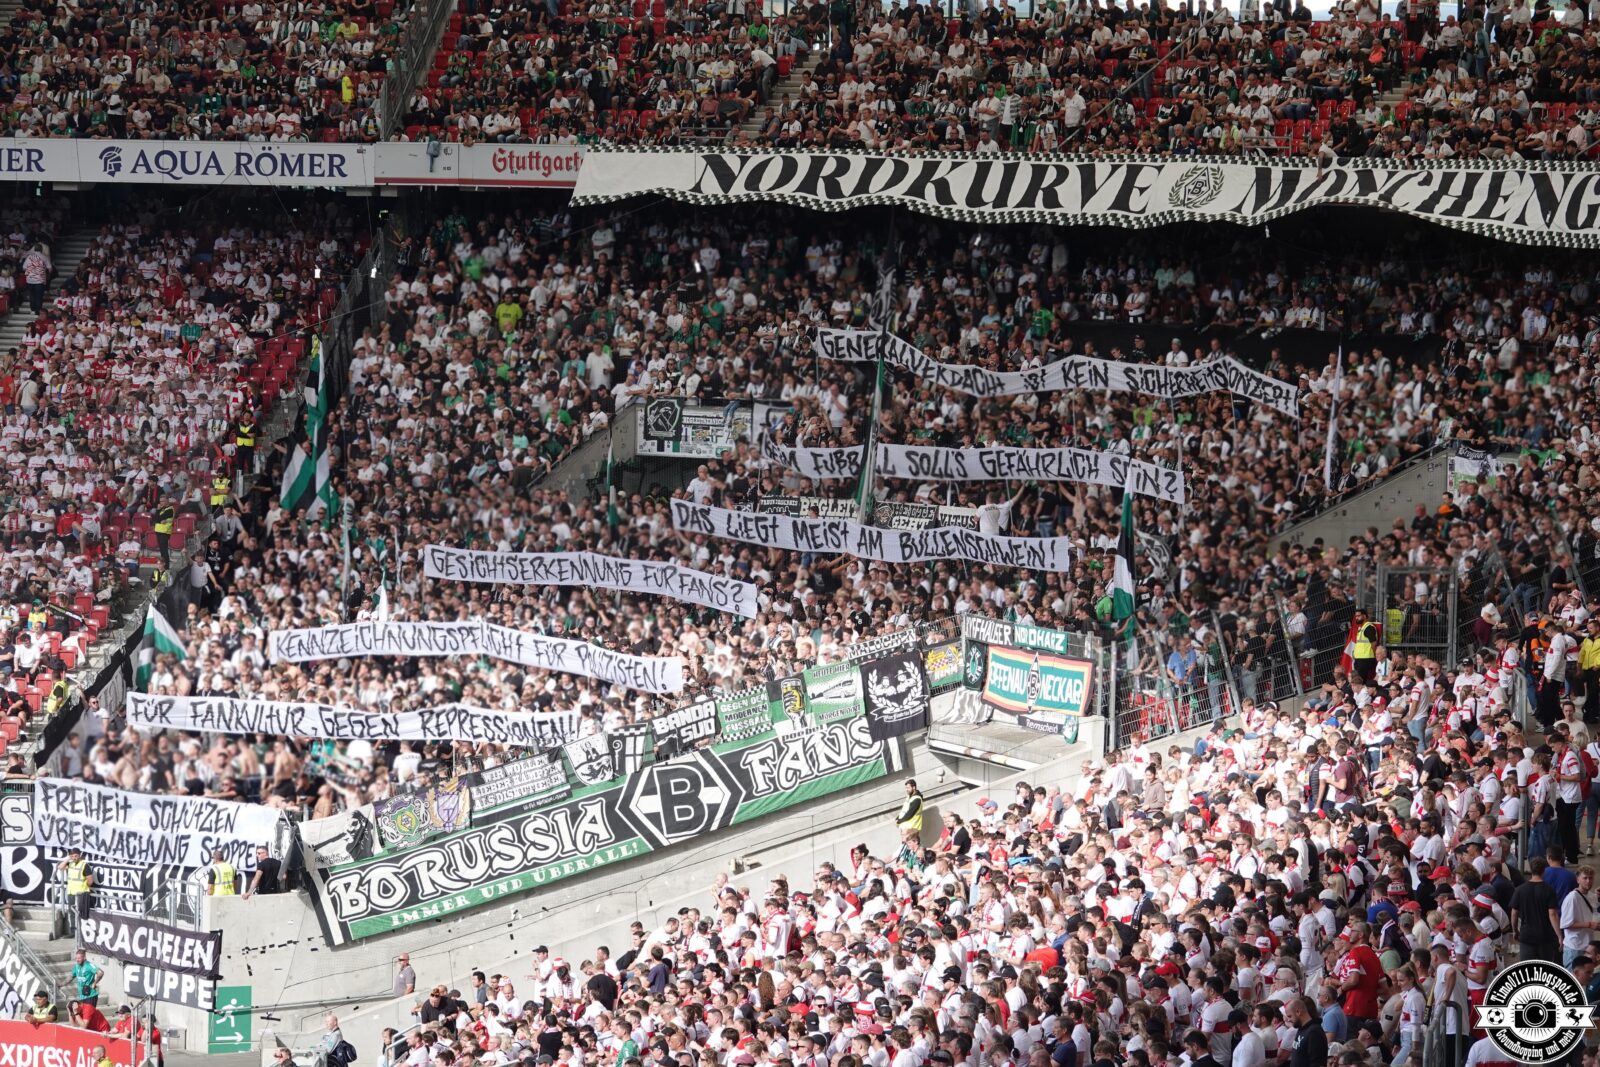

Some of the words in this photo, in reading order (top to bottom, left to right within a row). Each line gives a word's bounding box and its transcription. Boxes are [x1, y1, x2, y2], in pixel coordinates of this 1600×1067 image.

[131, 152, 227, 180] AQUA
[235, 146, 348, 178] RÖMER
[492, 147, 583, 177] Stuttgart
[691, 153, 1165, 214] NORDKURVE
[674, 502, 716, 534] DAS
[857, 526, 884, 559] AM
[642, 564, 677, 593] FÜR
[678, 573, 745, 612] FANS?
[532, 639, 567, 666] FÜR
[1014, 625, 1066, 651] NORDHARZ
[720, 699, 748, 713] GEGEN
[749, 694, 768, 707] DEN
[989, 661, 1028, 695] OFFENAU
[1039, 673, 1084, 704] NECKAR
[131, 696, 175, 725] FÜR
[318, 706, 400, 739] GEGEN
[652, 700, 716, 735] BANDA
[725, 704, 768, 722] MODERNEN
[725, 715, 771, 732] FUSSBALL
[1026, 719, 1059, 733] Remscheid
[482, 767, 504, 782] WIR
[740, 715, 883, 797] FANS
[653, 764, 709, 838] B
[38, 812, 192, 865] ÜBERWACHUNG
[327, 798, 615, 921] BORUSSIA
[390, 895, 471, 927] IMMER
[480, 879, 523, 898] UND
[531, 842, 639, 883] ÜBERALL!
[80, 918, 215, 971] BRACHELEN
[124, 965, 214, 1010] FUPPE
